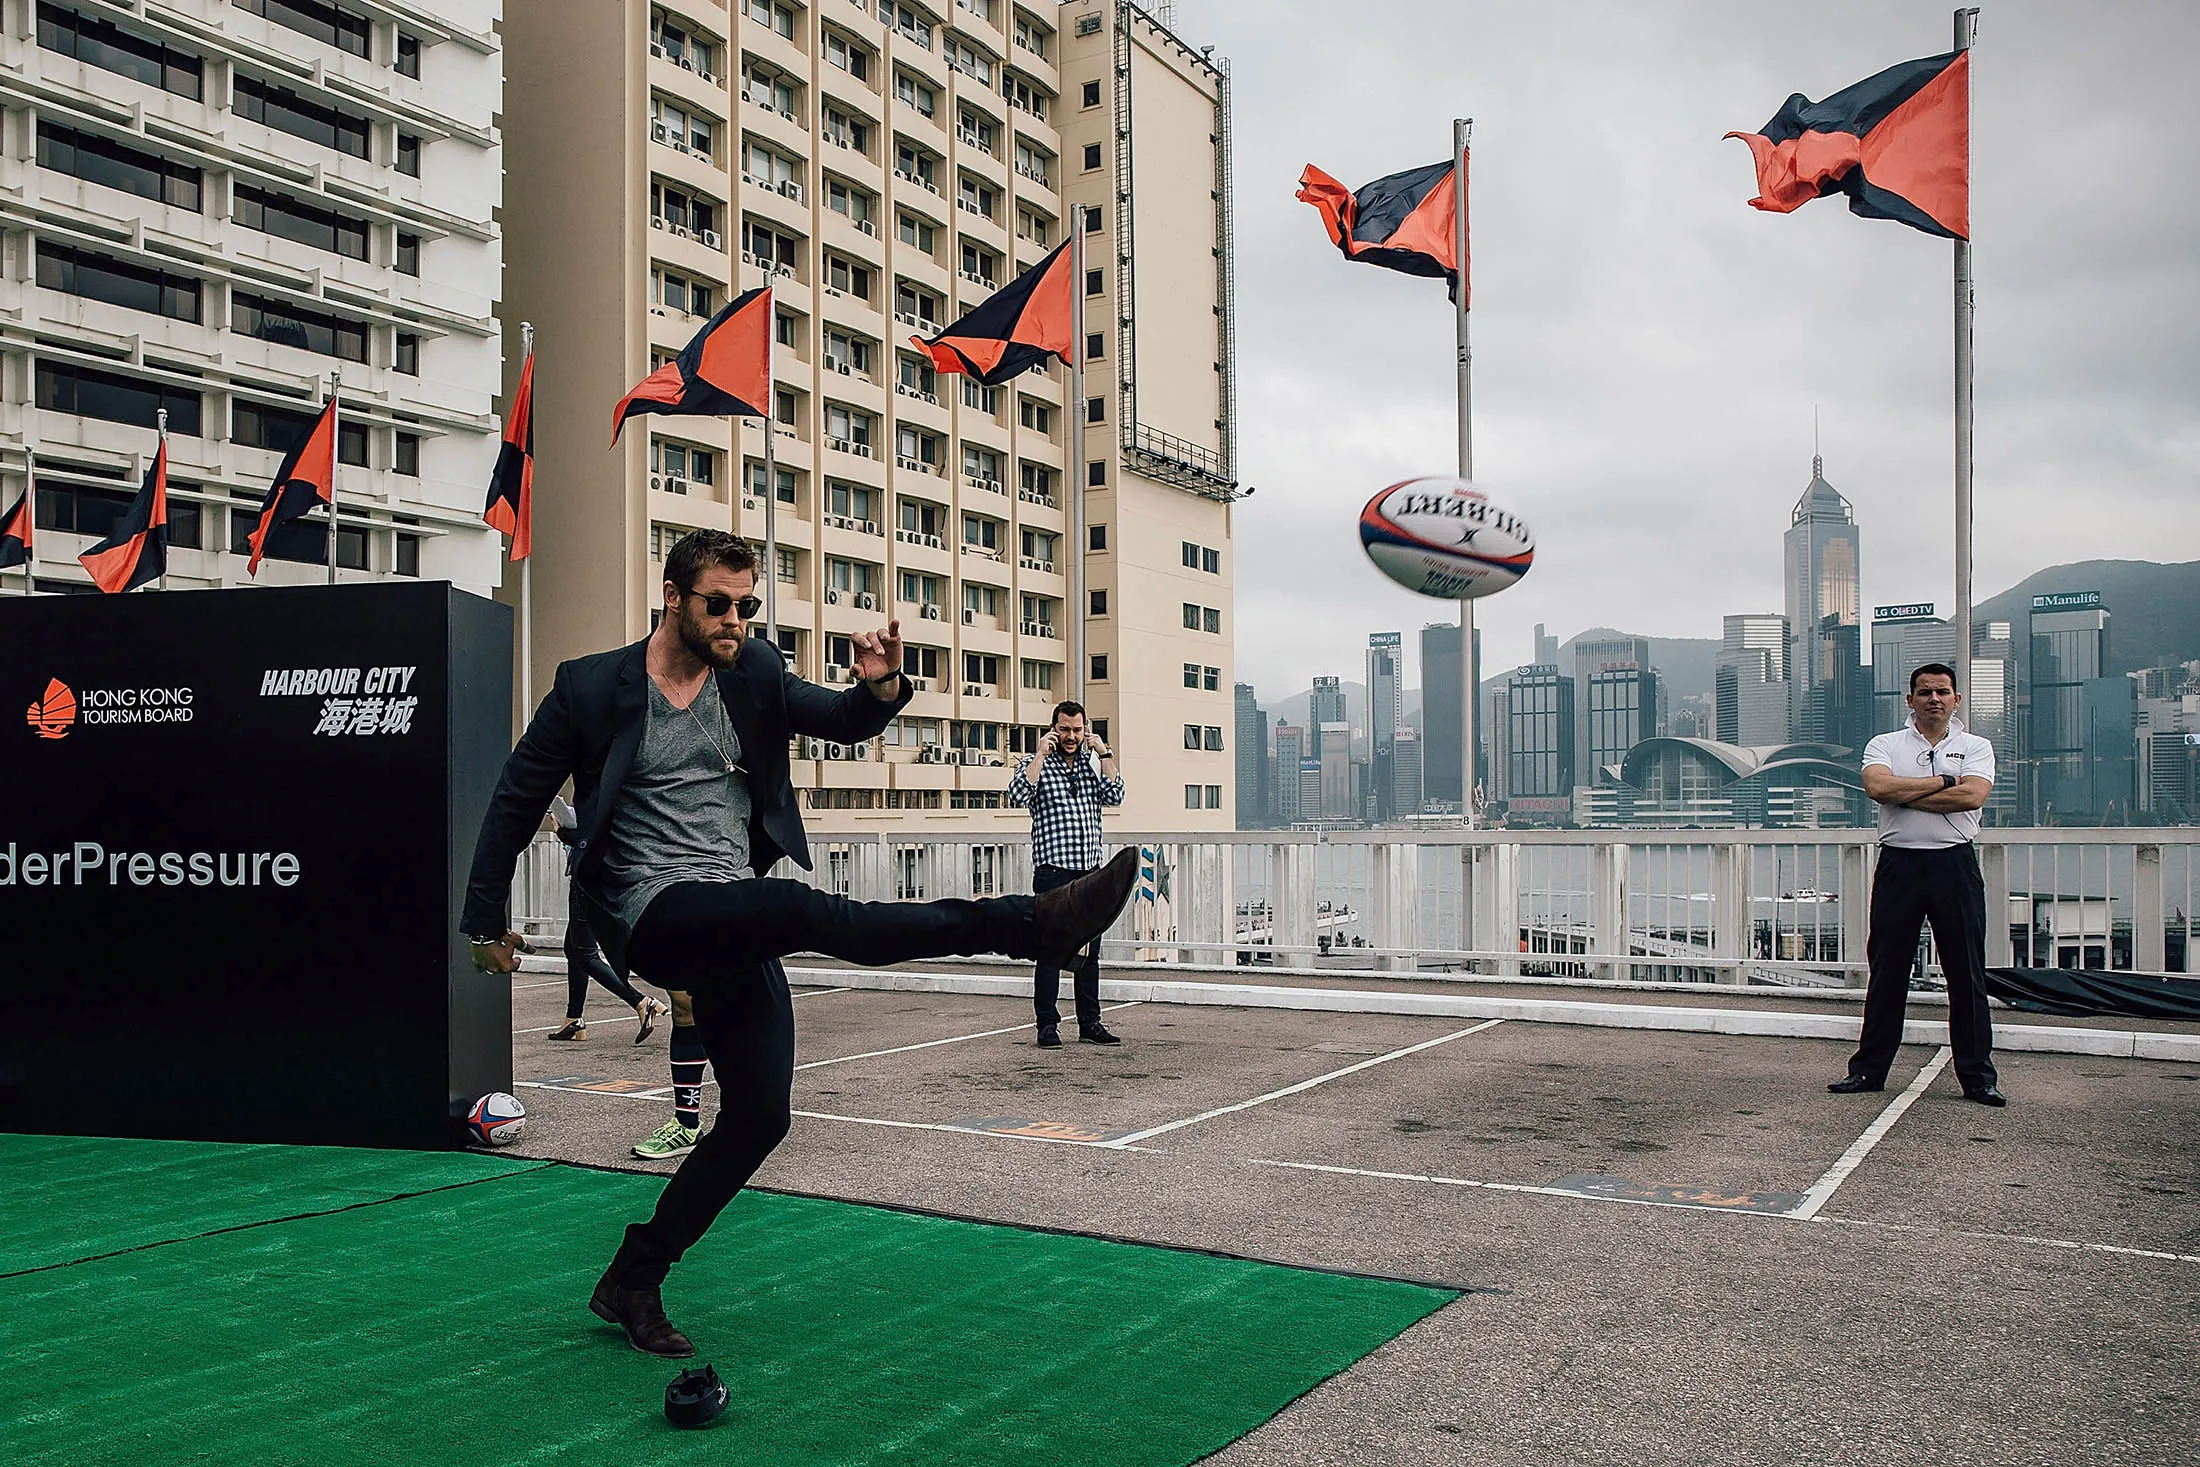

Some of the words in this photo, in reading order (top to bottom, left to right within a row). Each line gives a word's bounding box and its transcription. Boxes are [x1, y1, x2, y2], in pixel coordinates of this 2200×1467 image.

[1397, 494, 1530, 545] GILBERT
[2044, 592, 2099, 606] Manulife
[1875, 608, 1888, 617] LG
[1890, 606, 1919, 616] OLED
[1919, 605, 1932, 614] TV
[1370, 635, 1387, 643] CHINA
[260, 668, 361, 696] HARBOUR
[364, 666, 416, 694] CITY
[82, 689, 137, 707] HONG
[140, 687, 193, 706] KONG
[82, 709, 142, 724] TOURISM
[144, 708, 193, 723] BOARD
[312, 695, 418, 737] 海港城
[1509, 799, 1569, 811] HITACHI
[1462, 816, 1470, 826] 8
[0, 842, 300, 887] derPressure
